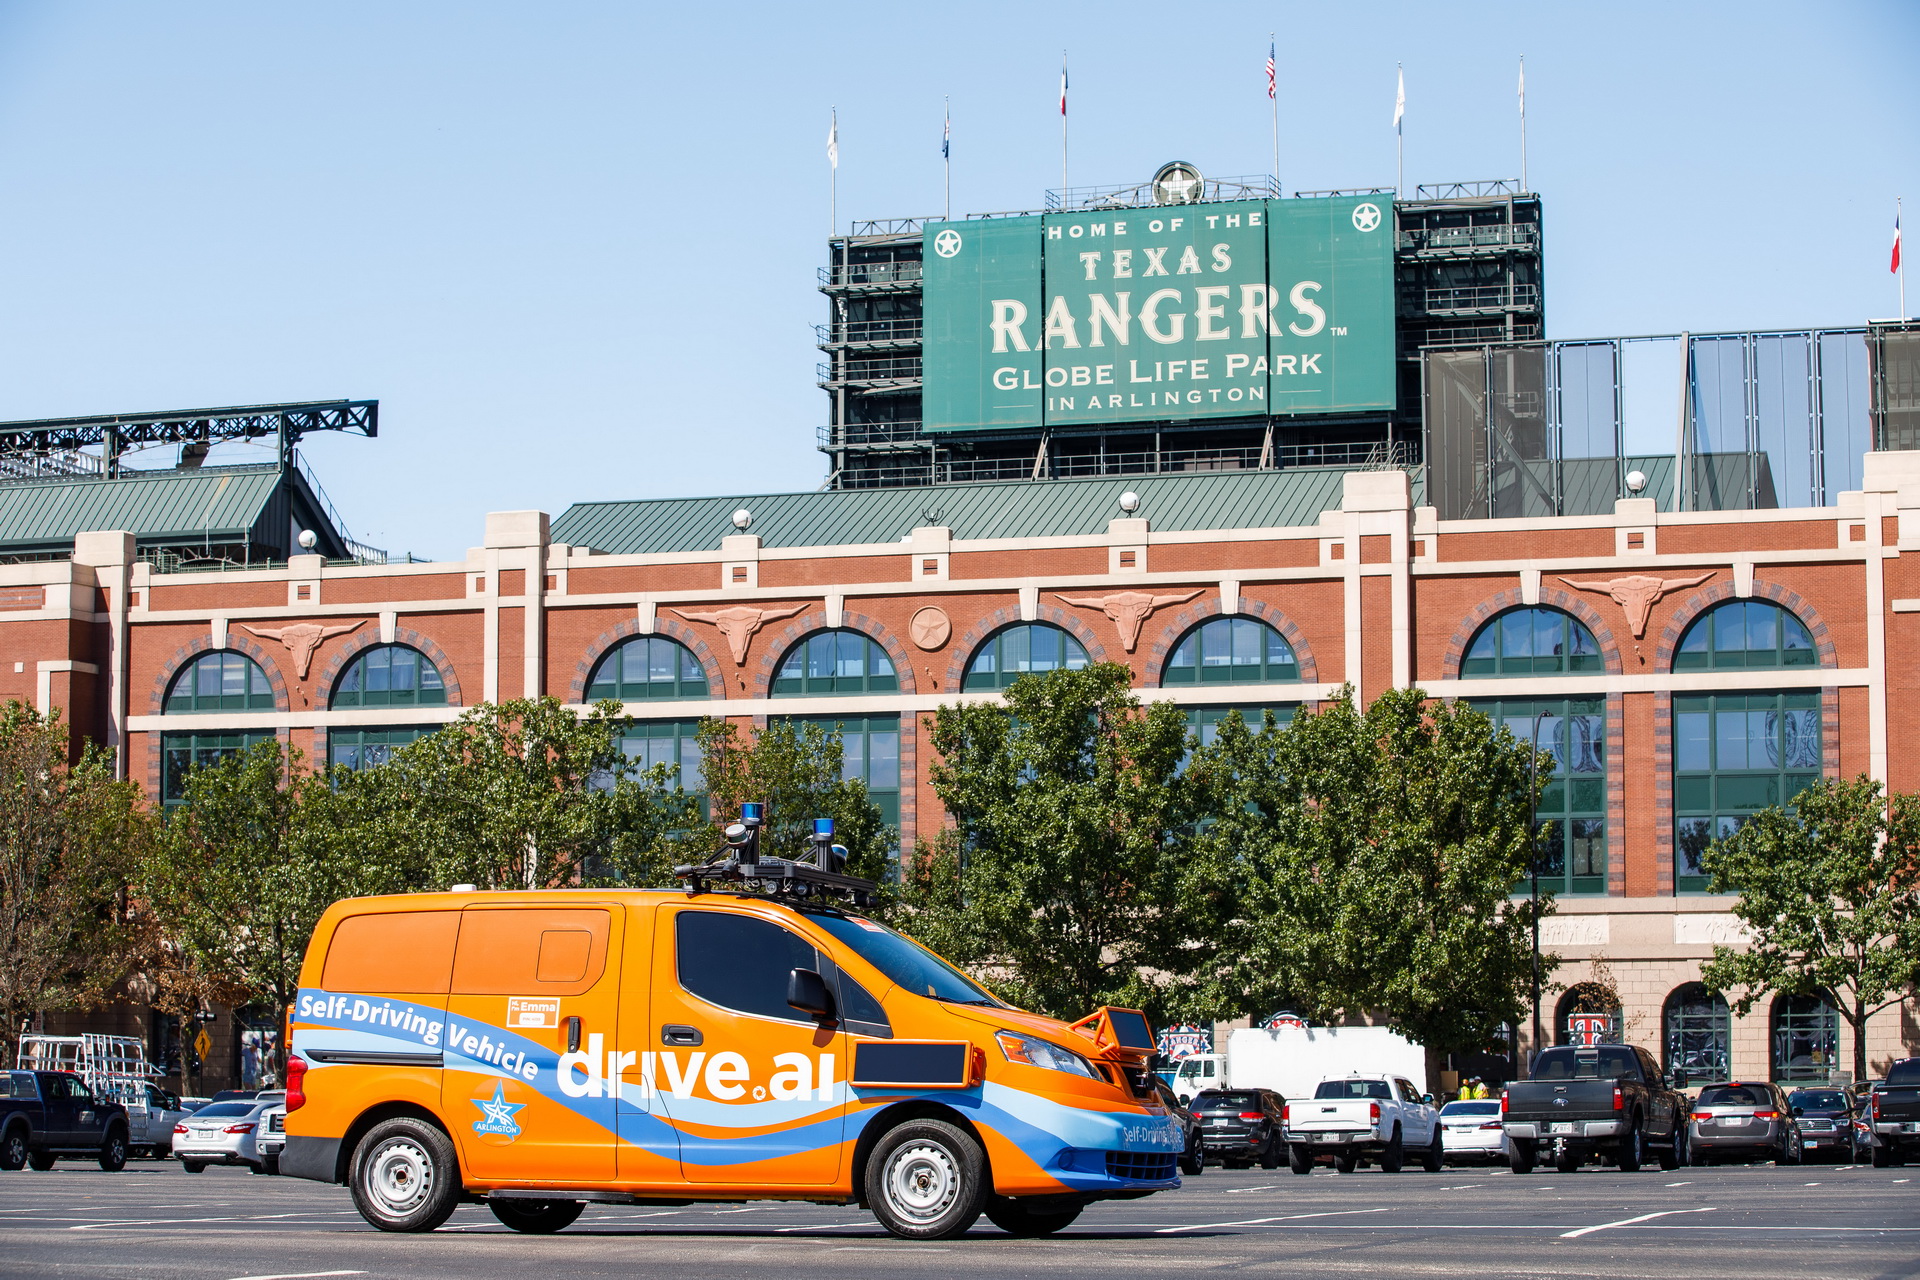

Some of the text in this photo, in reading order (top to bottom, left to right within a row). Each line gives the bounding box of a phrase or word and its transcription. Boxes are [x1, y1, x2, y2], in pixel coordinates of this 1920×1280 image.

[1048, 212, 1262, 240] HOME OF THE
[1079, 243, 1232, 281] TEXAS
[989, 280, 1327, 354] RANGERS
[1048, 386, 1265, 412] IN ARLINGTON
[520, 1001, 557, 1012] Emma
[299, 994, 539, 1081] Self-Driving Vehicle
[475, 1122, 518, 1134] ARLINGTON
